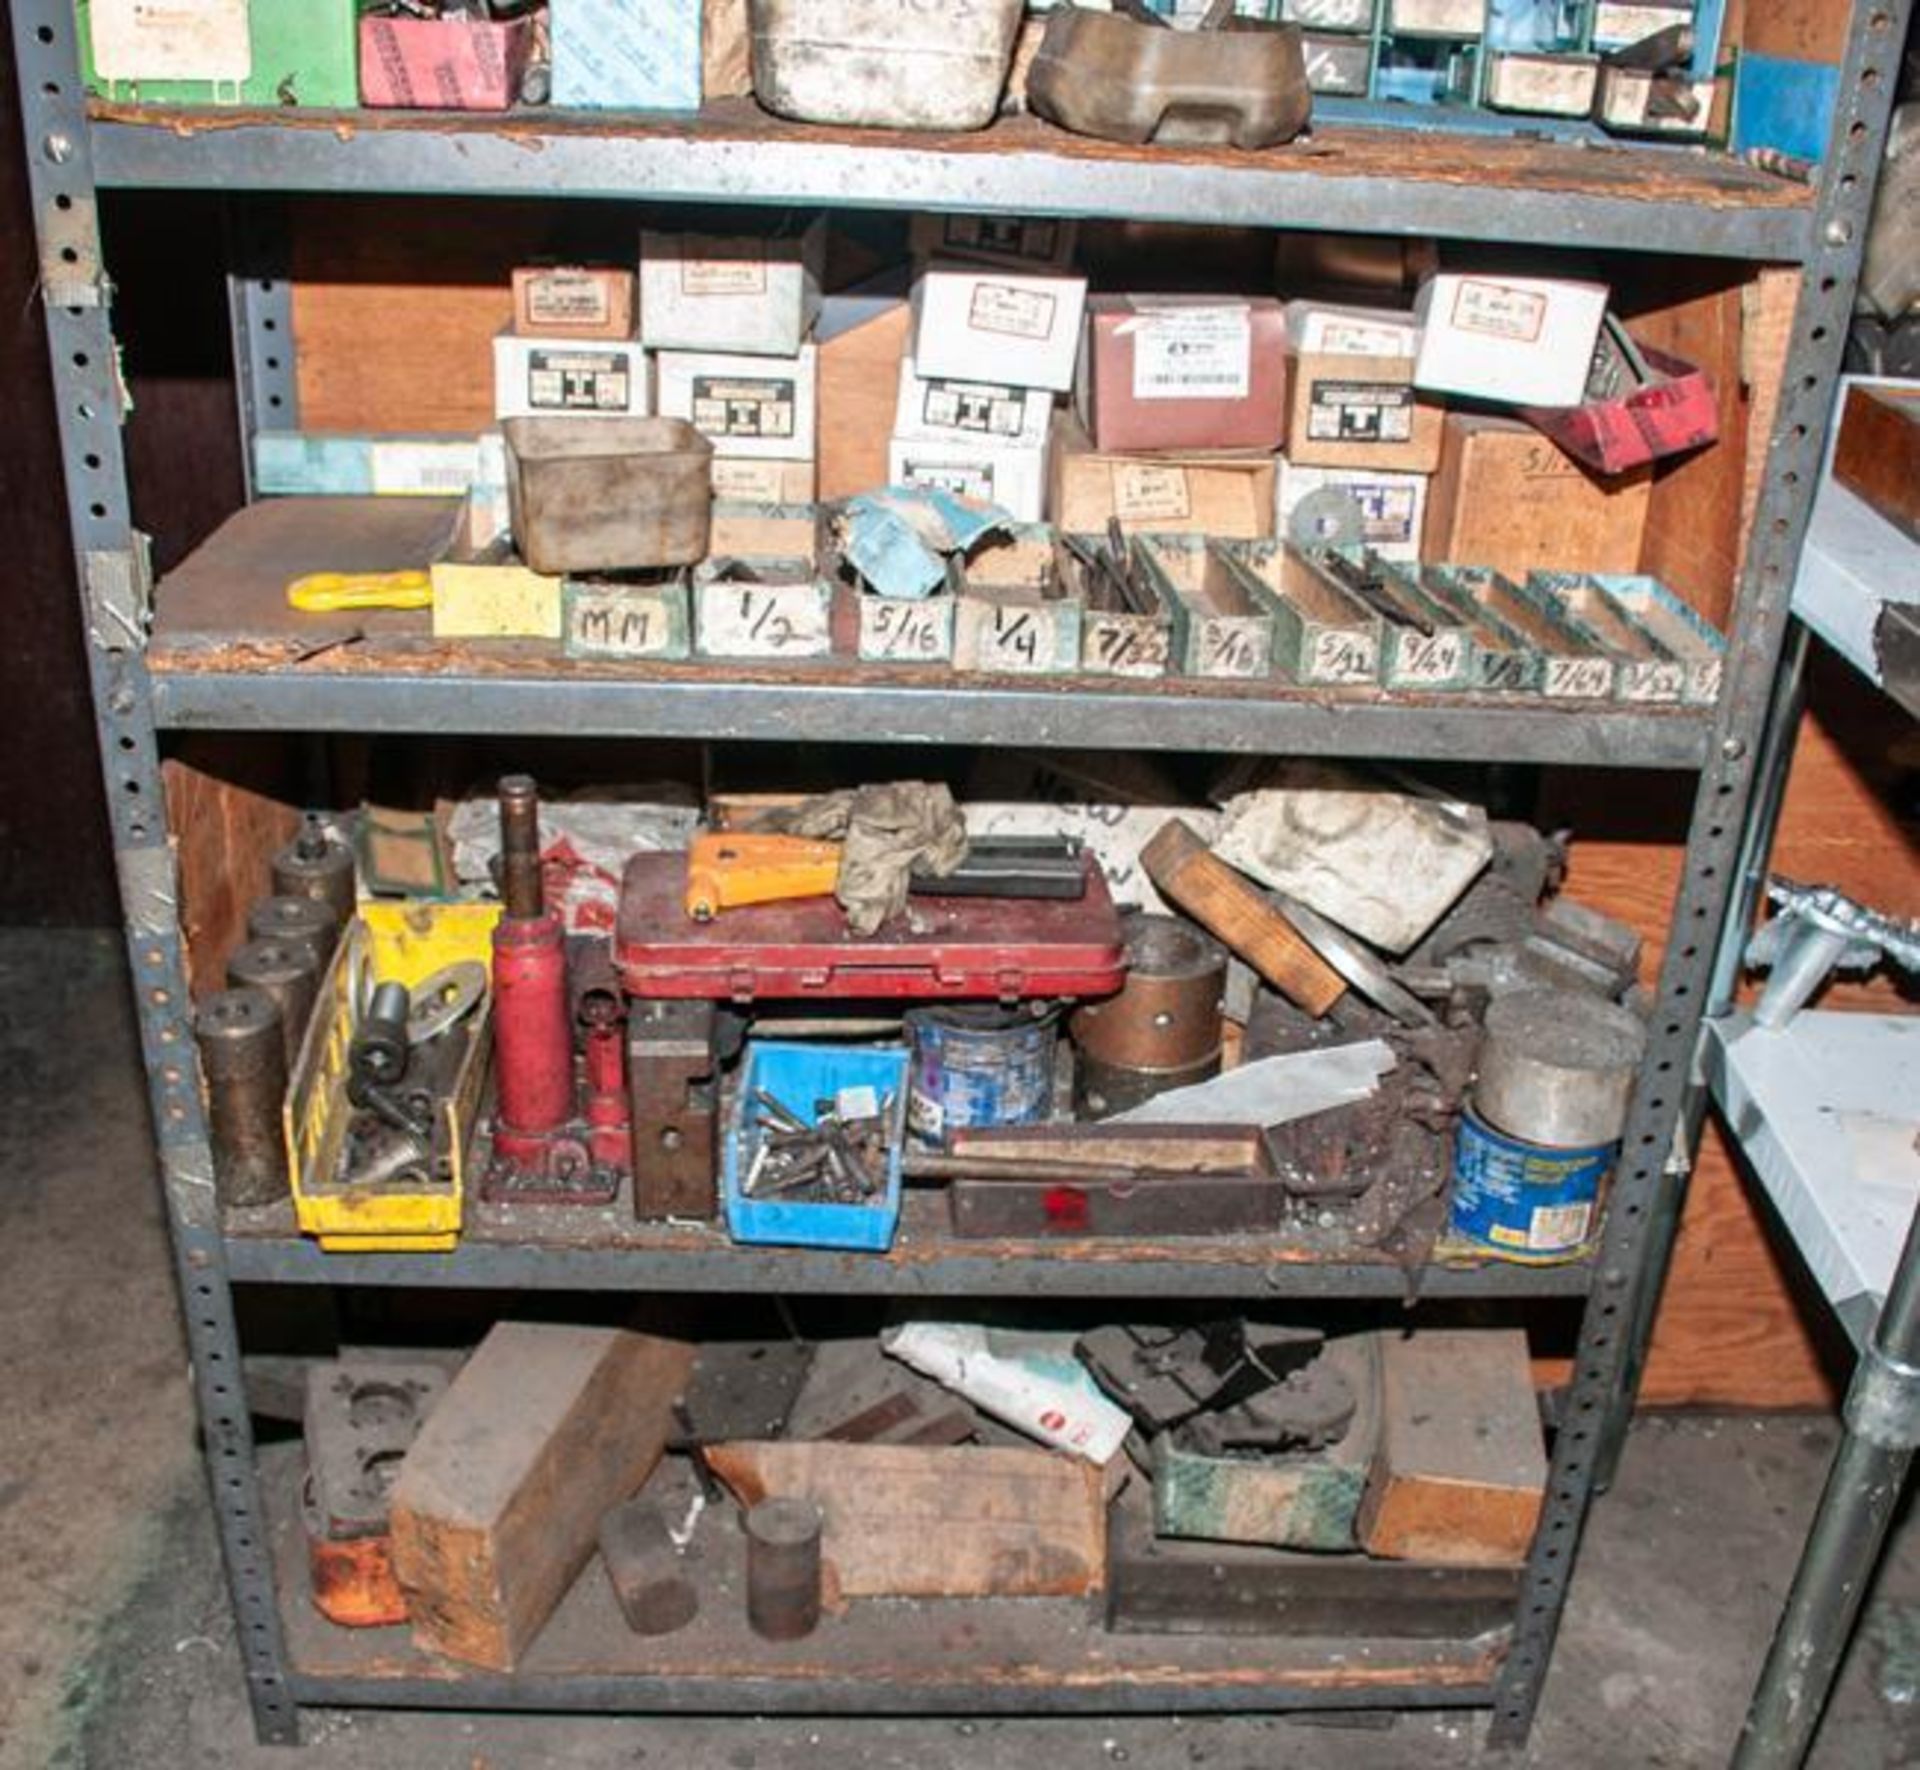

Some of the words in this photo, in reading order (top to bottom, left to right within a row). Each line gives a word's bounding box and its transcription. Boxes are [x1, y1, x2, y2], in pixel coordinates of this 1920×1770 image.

[740, 591, 814, 647] 1/2
[873, 606, 939, 655] 5/16
[995, 604, 1036, 662] 1/4
[1099, 627, 1164, 666] 7/32
